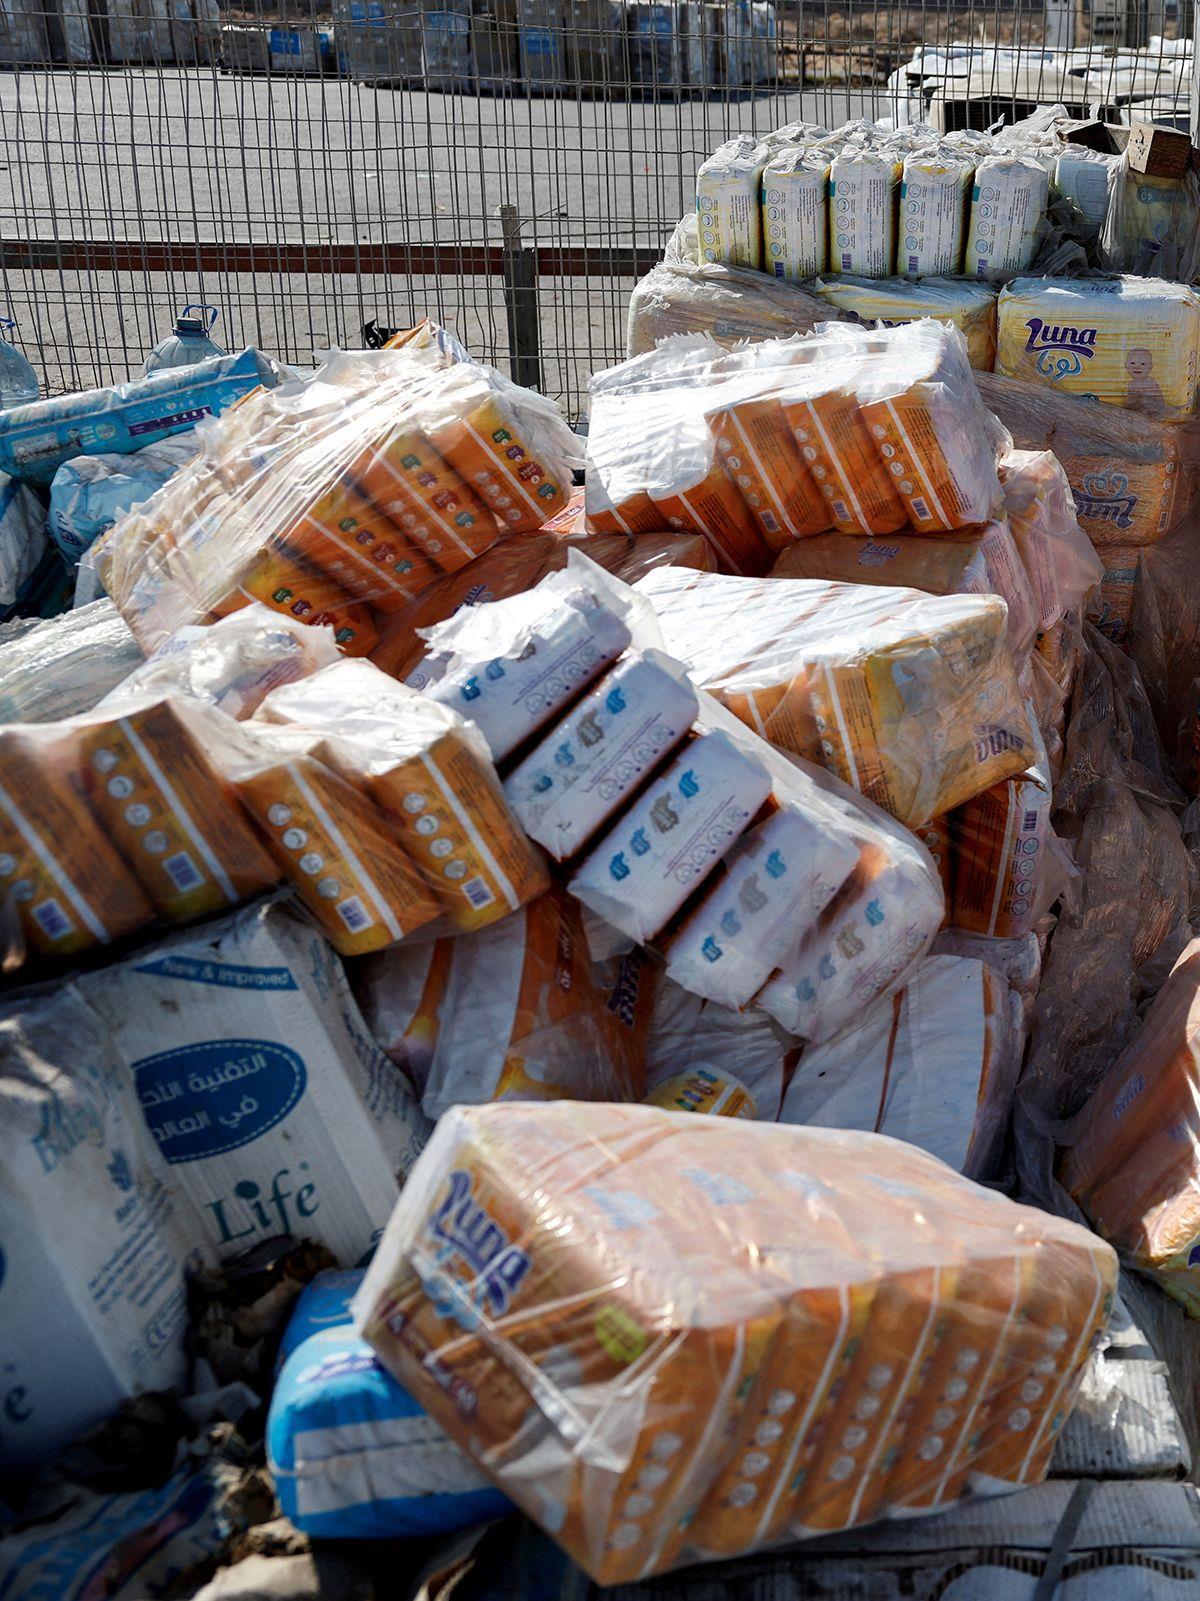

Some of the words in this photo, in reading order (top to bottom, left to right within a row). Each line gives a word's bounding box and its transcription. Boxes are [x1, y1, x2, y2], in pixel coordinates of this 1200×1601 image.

[1025, 318, 1098, 359] Luna
[1037, 350, 1083, 382] لونا
[162, 959, 199, 977] New
[202, 964, 215, 979] &
[218, 967, 290, 986] Improved
[188, 1053, 269, 1094] التقنية
[218, 1094, 260, 1129] في
[206, 1168, 320, 1245] Life
[427, 1168, 534, 1319] Luna
